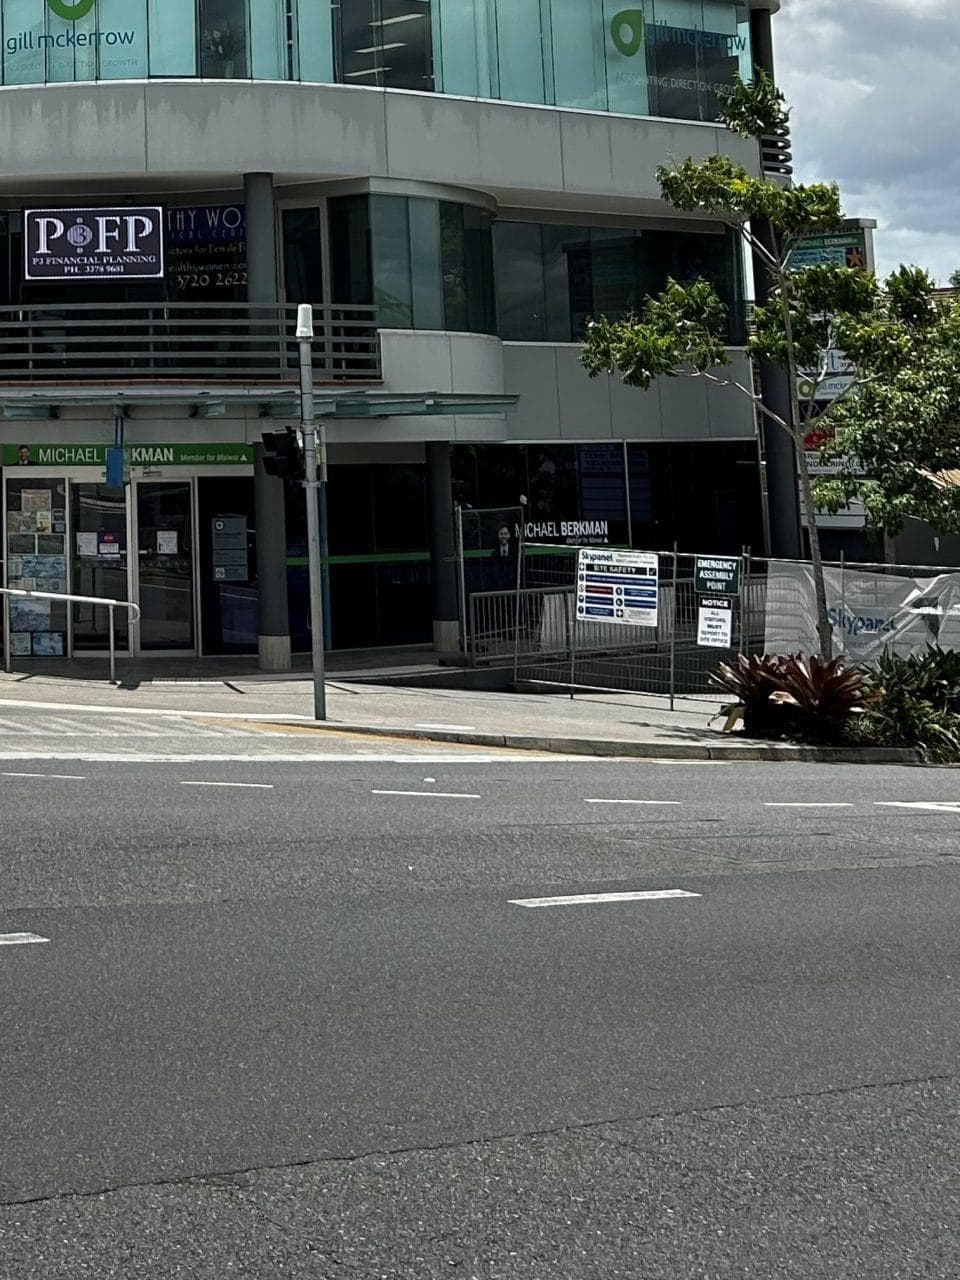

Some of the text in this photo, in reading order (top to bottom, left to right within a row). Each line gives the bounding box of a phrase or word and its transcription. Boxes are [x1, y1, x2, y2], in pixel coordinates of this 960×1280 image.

[7, 28, 136, 55] gill mckerrow
[45, 255, 102, 266] FINANCIAL
[103, 254, 157, 264] PLANNING
[176, 273, 210, 290] 3720
[38, 447, 101, 463] MICHAEL
[560, 520, 609, 536] BERKMAN
[581, 551, 614, 563] Skypanel
[609, 566, 637, 575] SAFETY
[697, 559, 737, 570] EMERGENCY
[699, 570, 734, 581] ASSEMBLY
[707, 581, 727, 591] POINT
[702, 599, 729, 608] NOTICE
